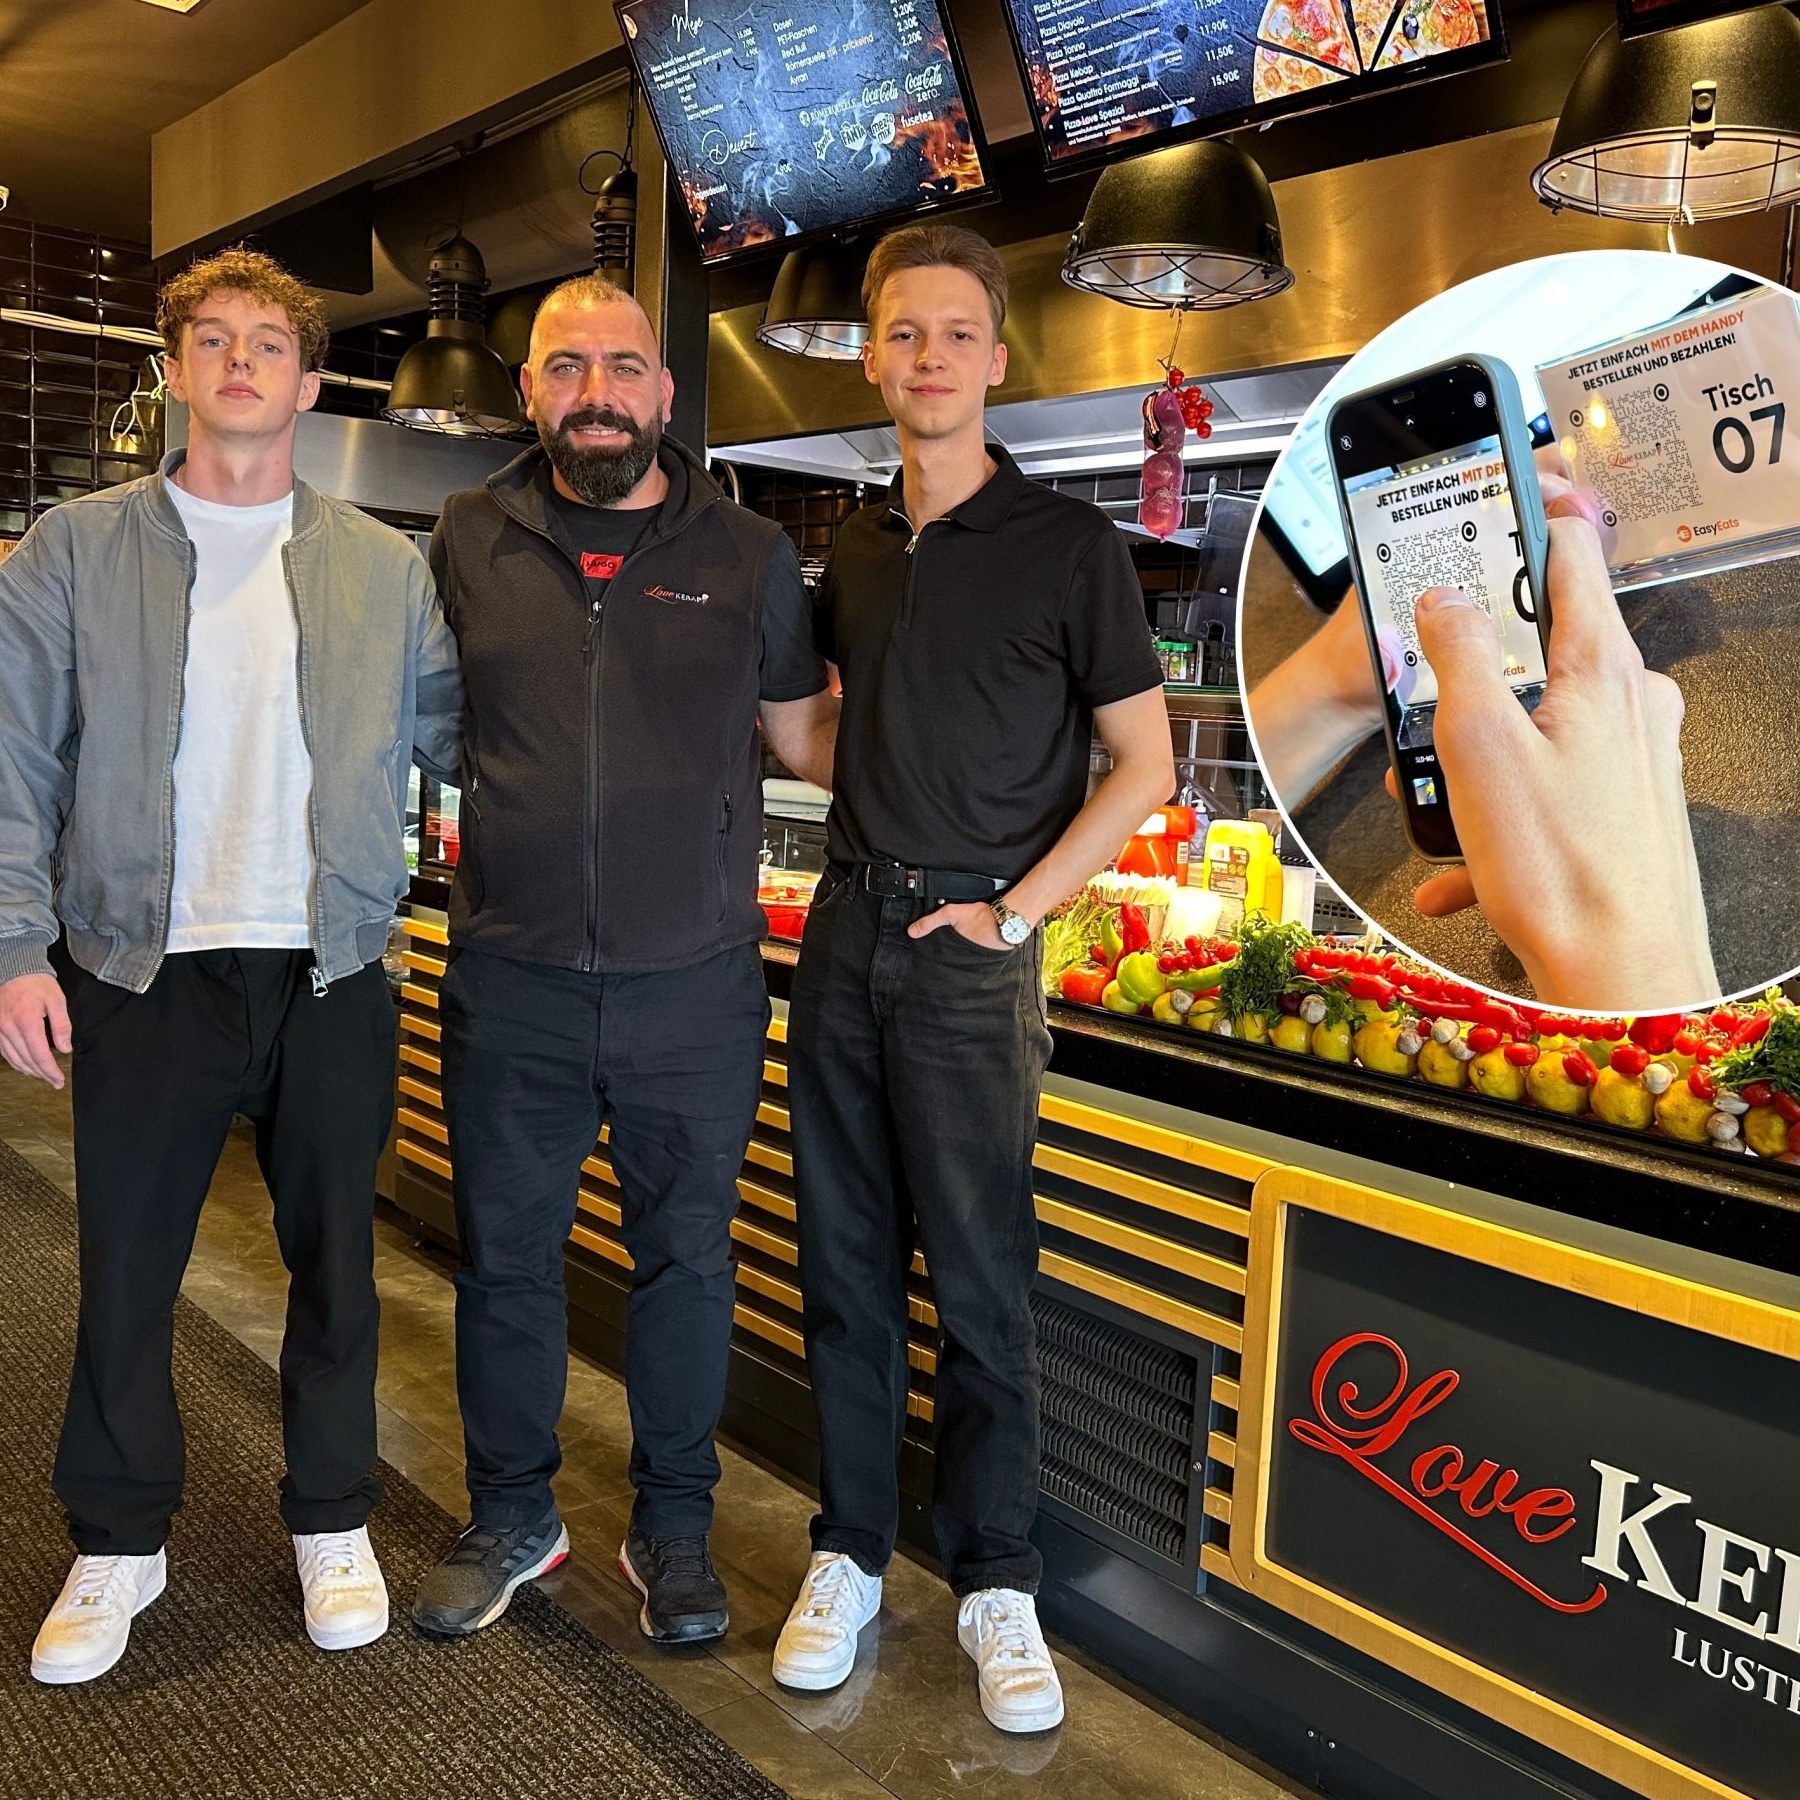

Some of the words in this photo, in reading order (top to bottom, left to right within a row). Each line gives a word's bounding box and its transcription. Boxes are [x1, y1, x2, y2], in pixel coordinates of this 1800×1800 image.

[773, 18, 794, 32] Dosen
[896, 15, 919, 33] 2,30€
[1039, 25, 1057, 38] Pizza
[1199, 18, 1229, 37] 11,90€
[777, 24, 818, 46] PET-Flaschen
[900, 30, 923, 47] 2,20€
[781, 47, 795, 60] Red
[795, 42, 808, 56] Bull
[785, 51, 826, 72] Römerquelle
[842, 32, 875, 52] prickelnd
[1045, 50, 1064, 61] Pizza
[1064, 41, 1086, 55] Tonno
[1205, 44, 1234, 61] 11,50€
[790, 72, 809, 86] Ayran
[1052, 72, 1069, 84] Pizza
[1069, 65, 1094, 80] Kebap
[1211, 69, 1240, 87] 15,90€
[1058, 96, 1075, 107] Pizza
[1075, 86, 1103, 102] Quattro
[1103, 75, 1140, 94] Formaggi
[900, 111, 935, 129] fusetea
[1098, 104, 1125, 121] Spezial
[877, 126, 892, 142] mix
[1567, 359, 1600, 380] JETZT
[1600, 343, 1650, 369] EINFACH
[1650, 335, 1672, 352] MIT
[1673, 327, 1700, 345] DEM
[1700, 310, 1745, 337] HANDY
[1582, 364, 1643, 392] BESTELLEN
[1643, 355, 1669, 373] UND
[1671, 333, 1736, 364] BEZAHLEN!
[1701, 373, 1775, 412] Tisch
[1712, 402, 1785, 474] 07
[1376, 488, 1408, 509] JETZT
[1410, 473, 1460, 499] EINFACH
[1462, 467, 1483, 485] MIT
[1390, 496, 1451, 524] BESTELLEN
[1453, 489, 1479, 508] UND
[1693, 517, 1740, 537] EasyEats
[1287, 1331, 1607, 1614] Love
